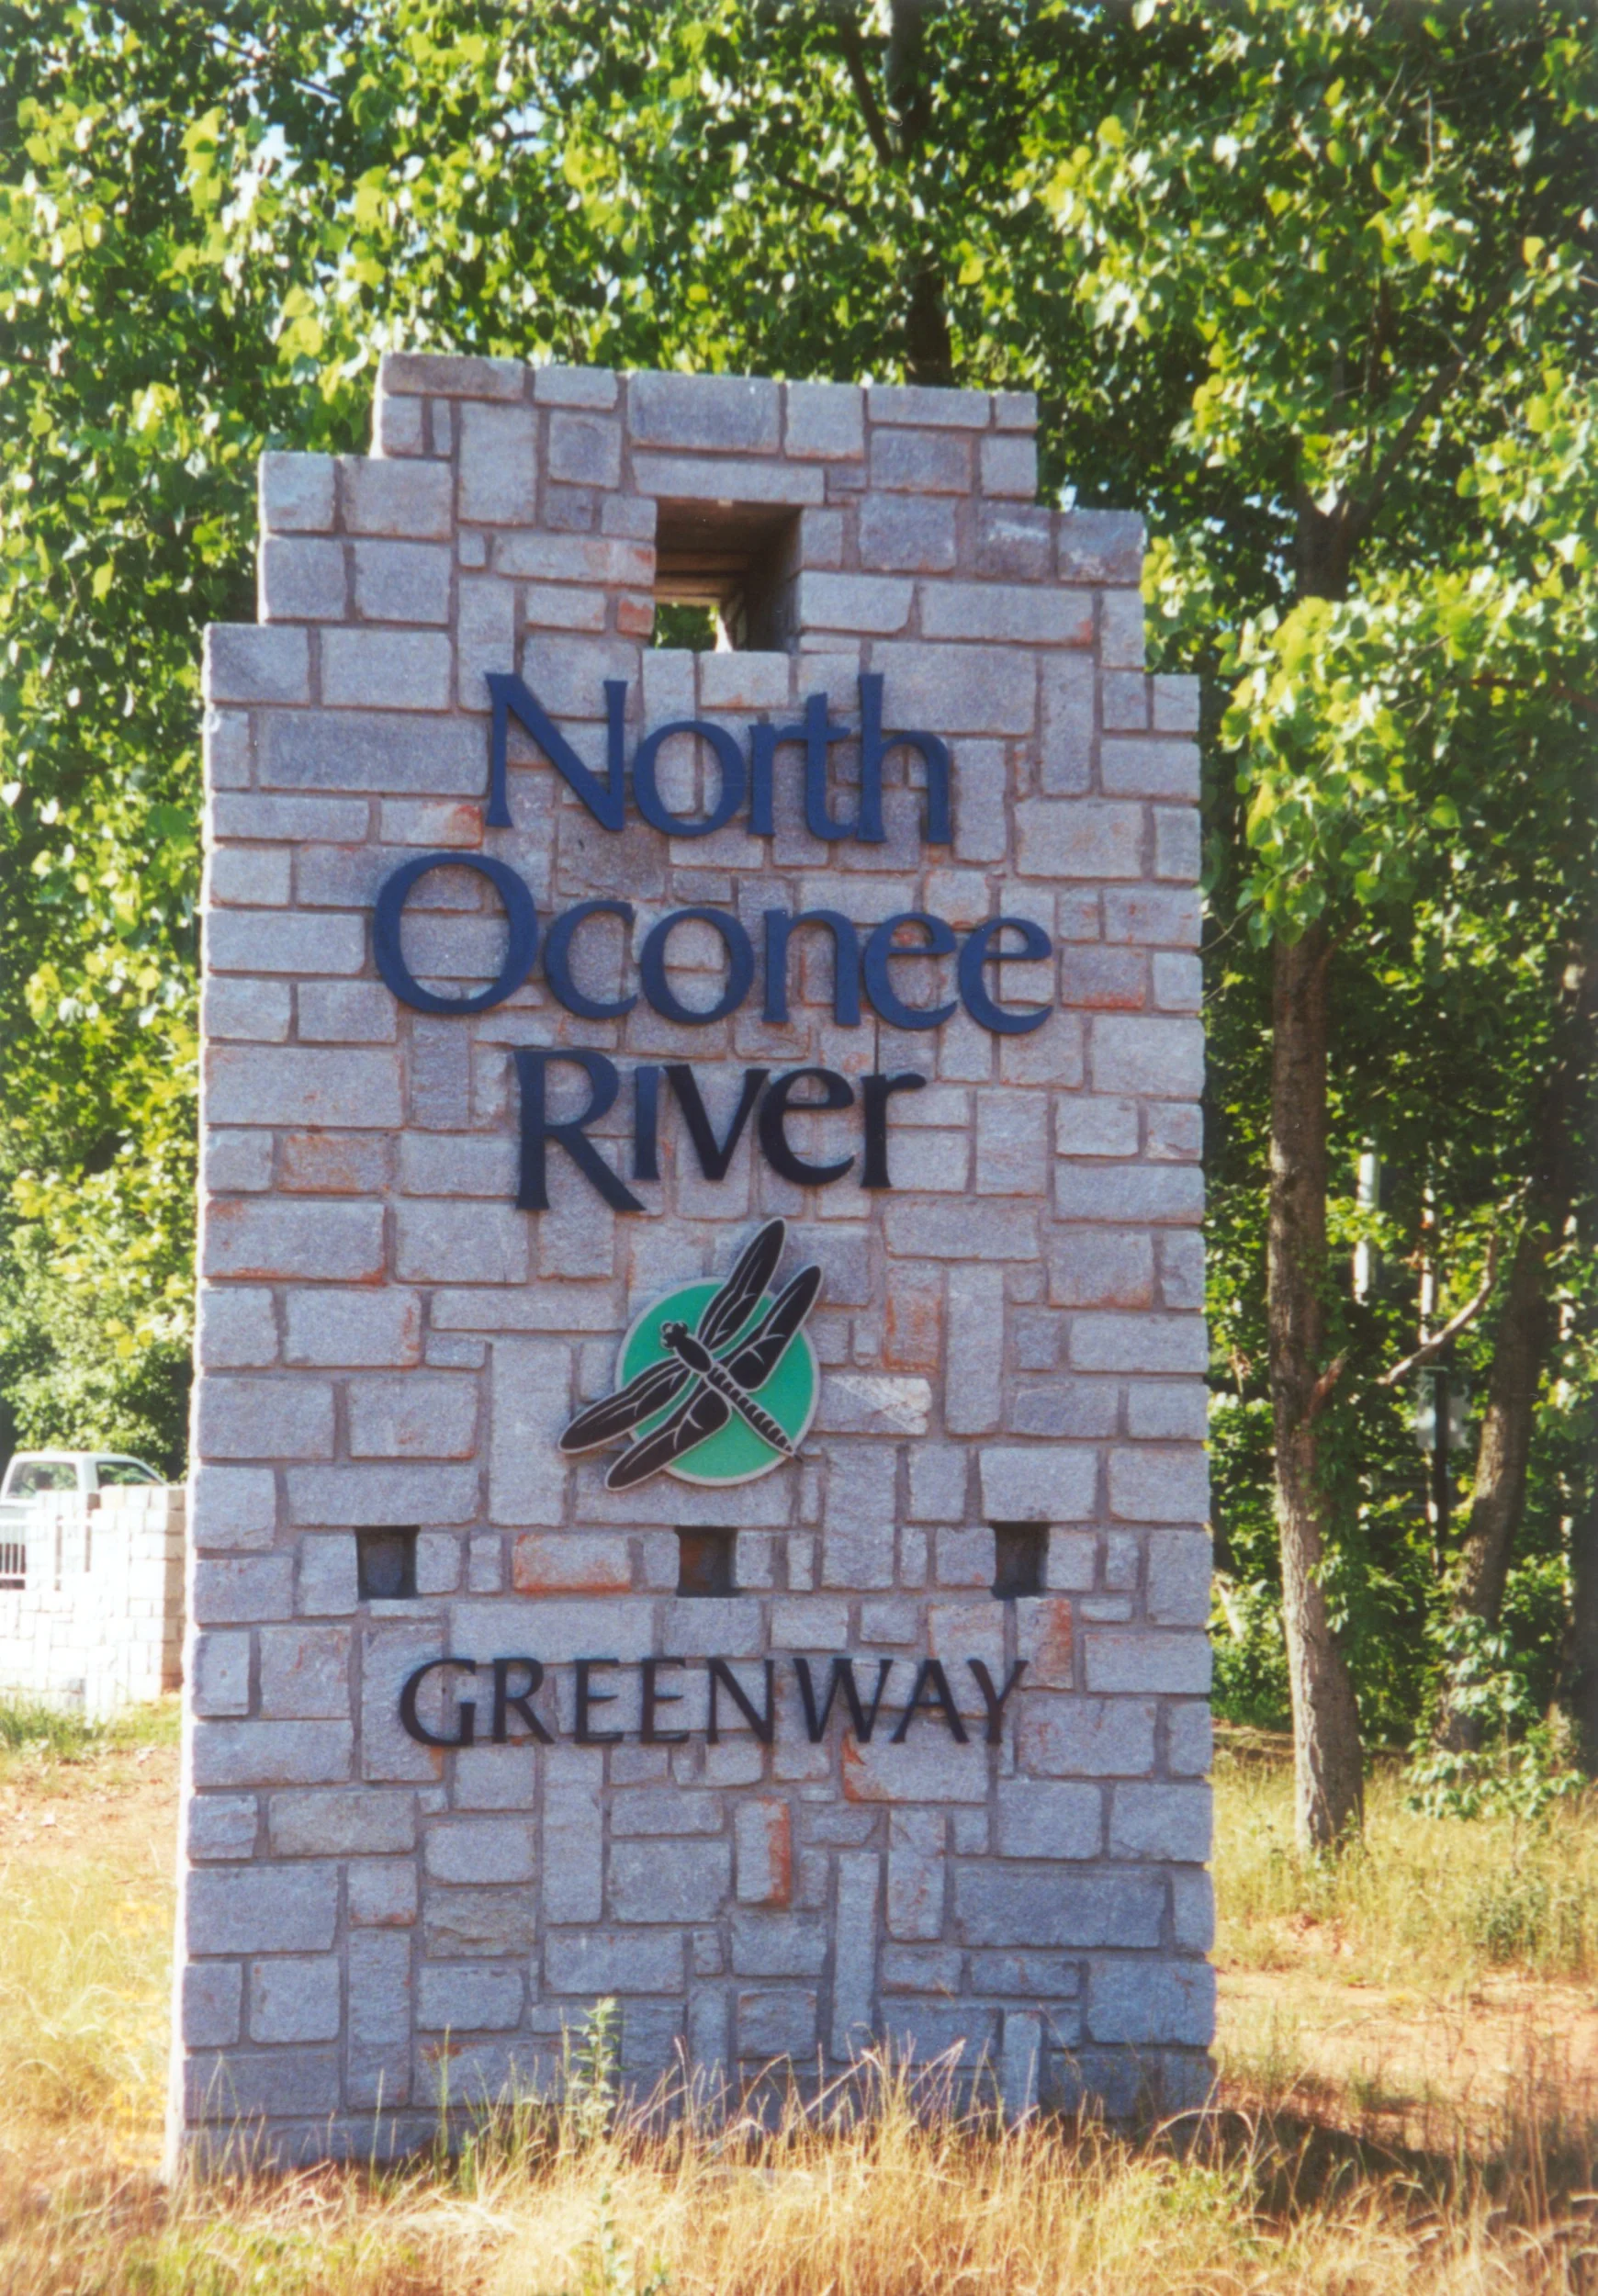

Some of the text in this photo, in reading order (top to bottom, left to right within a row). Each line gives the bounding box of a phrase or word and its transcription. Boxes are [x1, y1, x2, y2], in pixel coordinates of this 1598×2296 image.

[485, 673, 954, 844] North
[372, 852, 1053, 1034] Oconee
[514, 1049, 927, 1211] River
[400, 1657, 1029, 1745] GREENWAY
